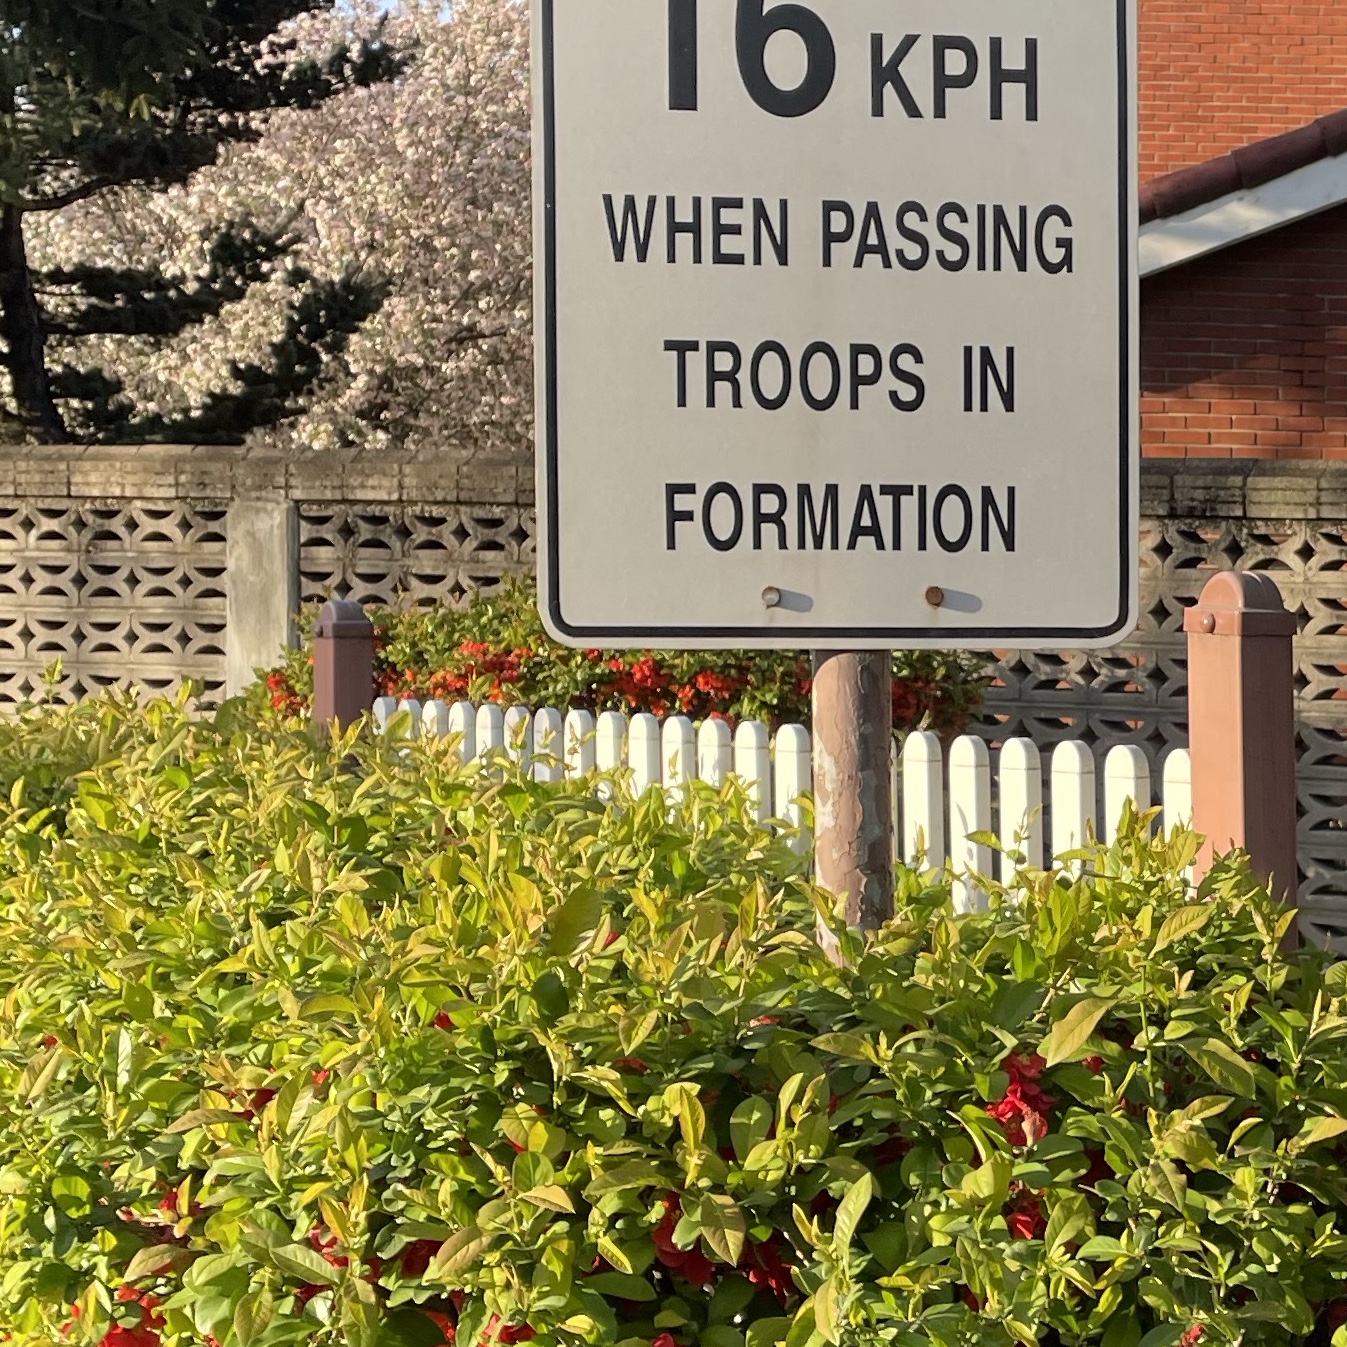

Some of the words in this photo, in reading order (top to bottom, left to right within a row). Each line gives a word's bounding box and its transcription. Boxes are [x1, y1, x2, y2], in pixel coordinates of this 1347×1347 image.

[870, 32, 1039, 122] KPH
[601, 193, 789, 267] WHEN
[821, 199, 1074, 275] PASSING
[663, 339, 926, 413] TROOPS
[963, 345, 1015, 413] IN
[664, 481, 1016, 554] FORMATION
